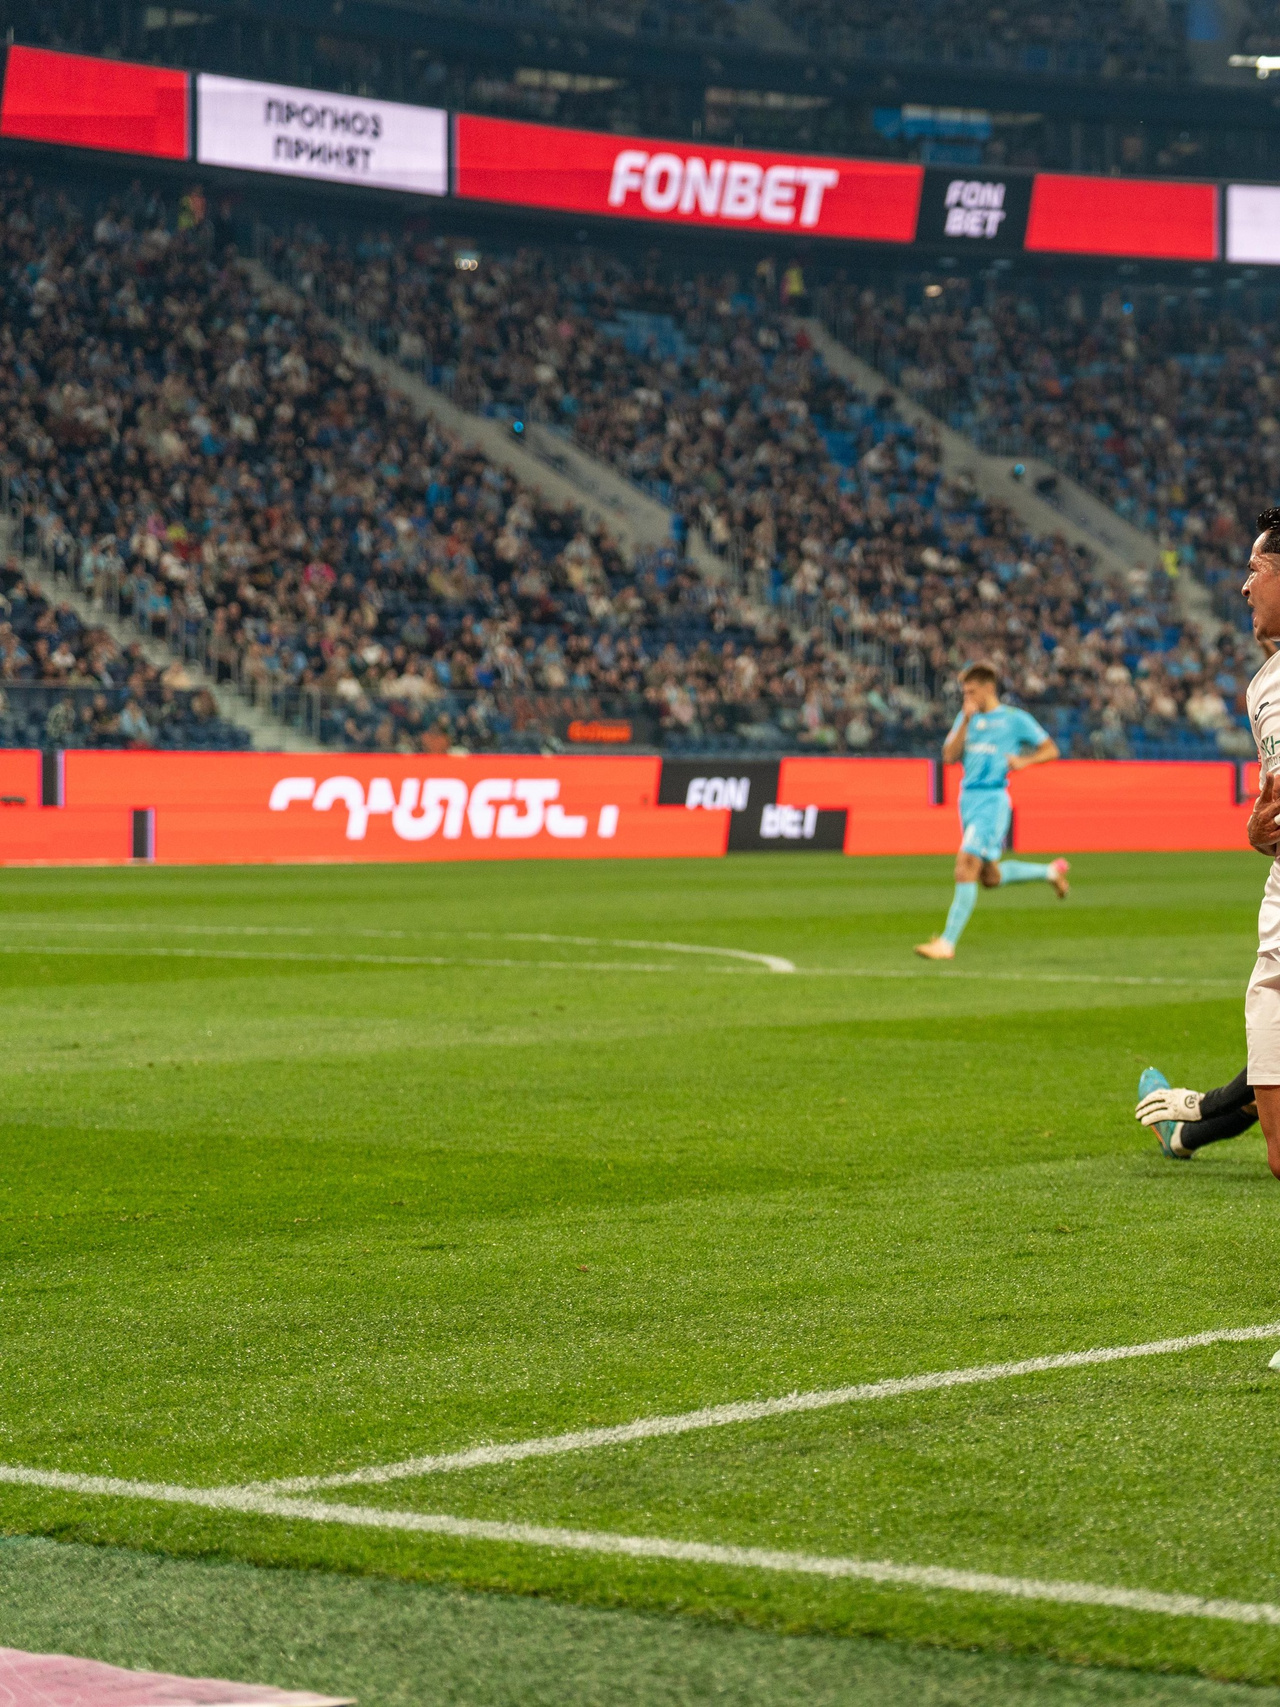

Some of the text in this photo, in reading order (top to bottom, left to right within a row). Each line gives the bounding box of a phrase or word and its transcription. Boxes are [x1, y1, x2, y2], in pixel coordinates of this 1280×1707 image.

[265, 98, 383, 138] ПРОГНОЗ
[274, 136, 373, 169] ПРИНЯТ
[608, 149, 839, 228] FONBET
[944, 180, 1006, 208] FON
[944, 207, 1006, 238] BET
